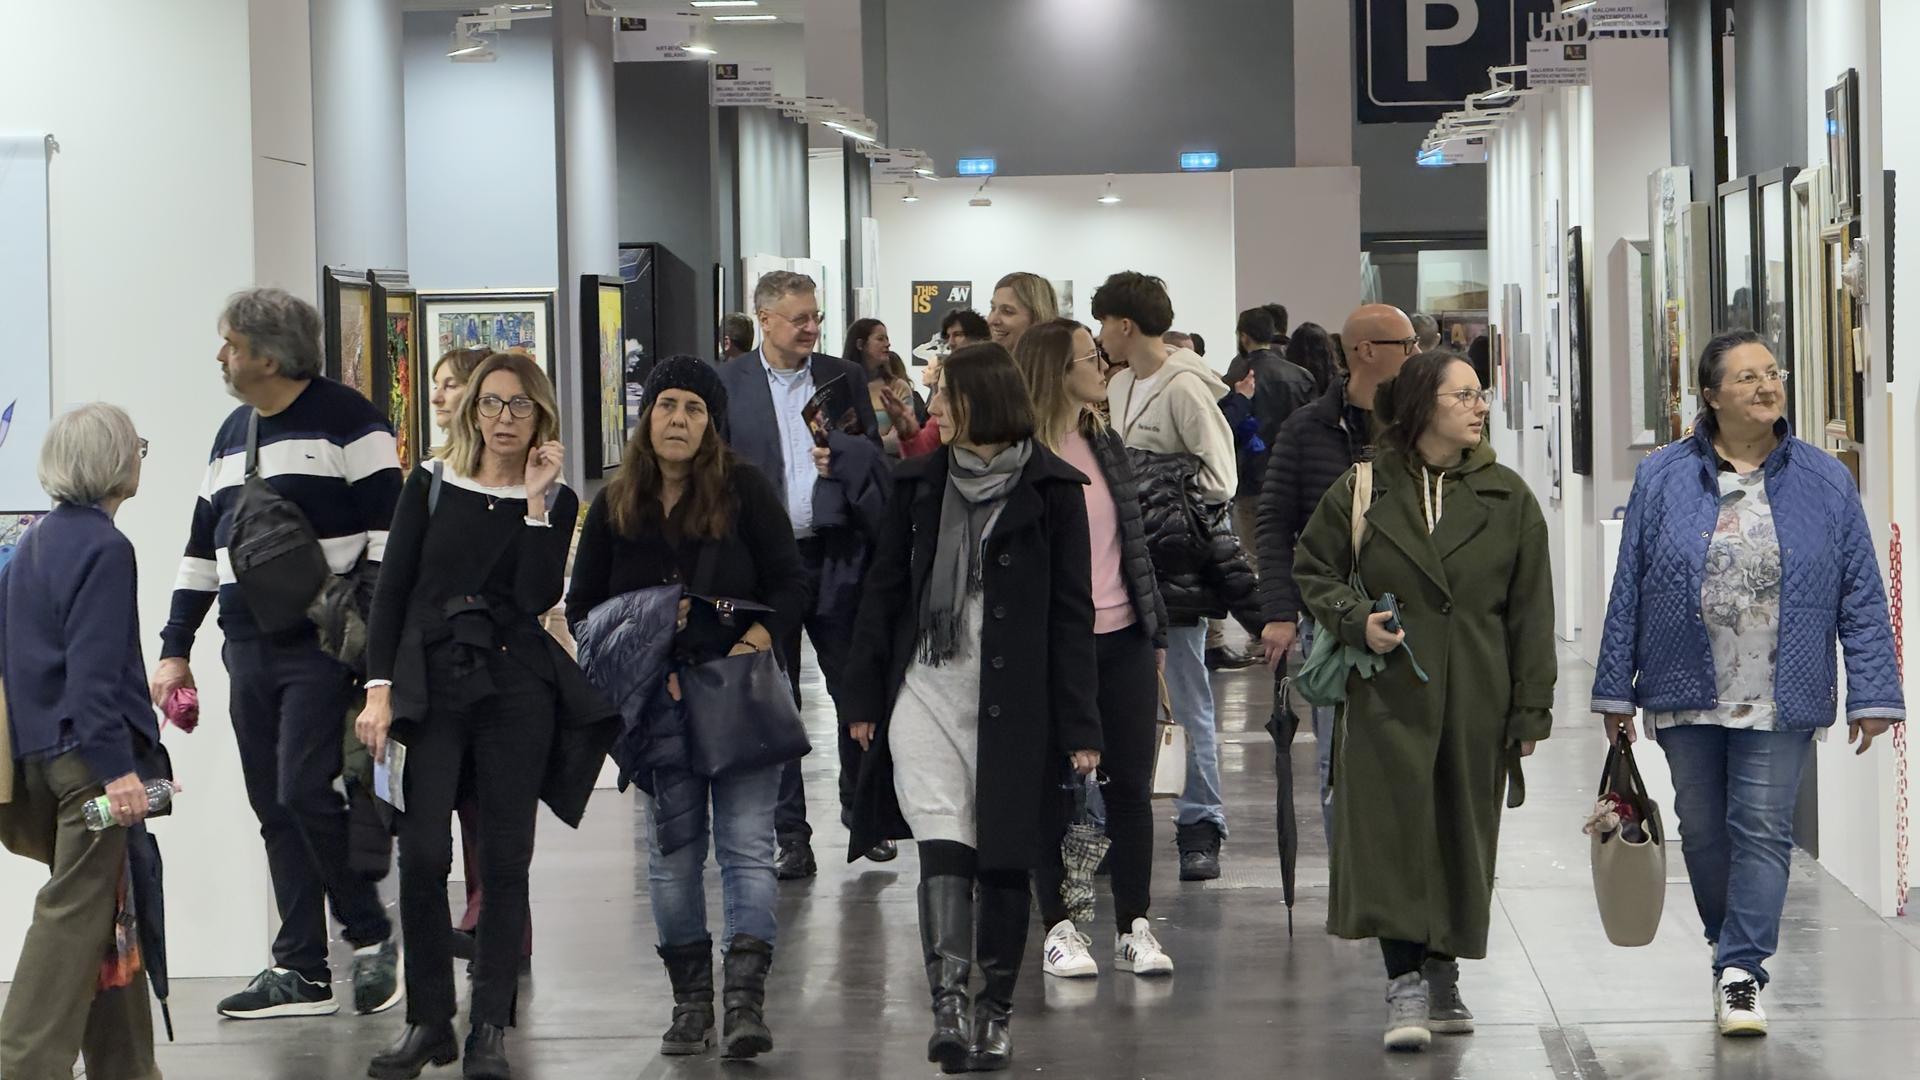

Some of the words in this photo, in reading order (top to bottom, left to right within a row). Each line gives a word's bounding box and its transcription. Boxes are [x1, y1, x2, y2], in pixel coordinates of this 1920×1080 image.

[1407, 0, 1479, 82] P
[915, 285, 938, 296] THIS
[913, 295, 931, 313] IS
